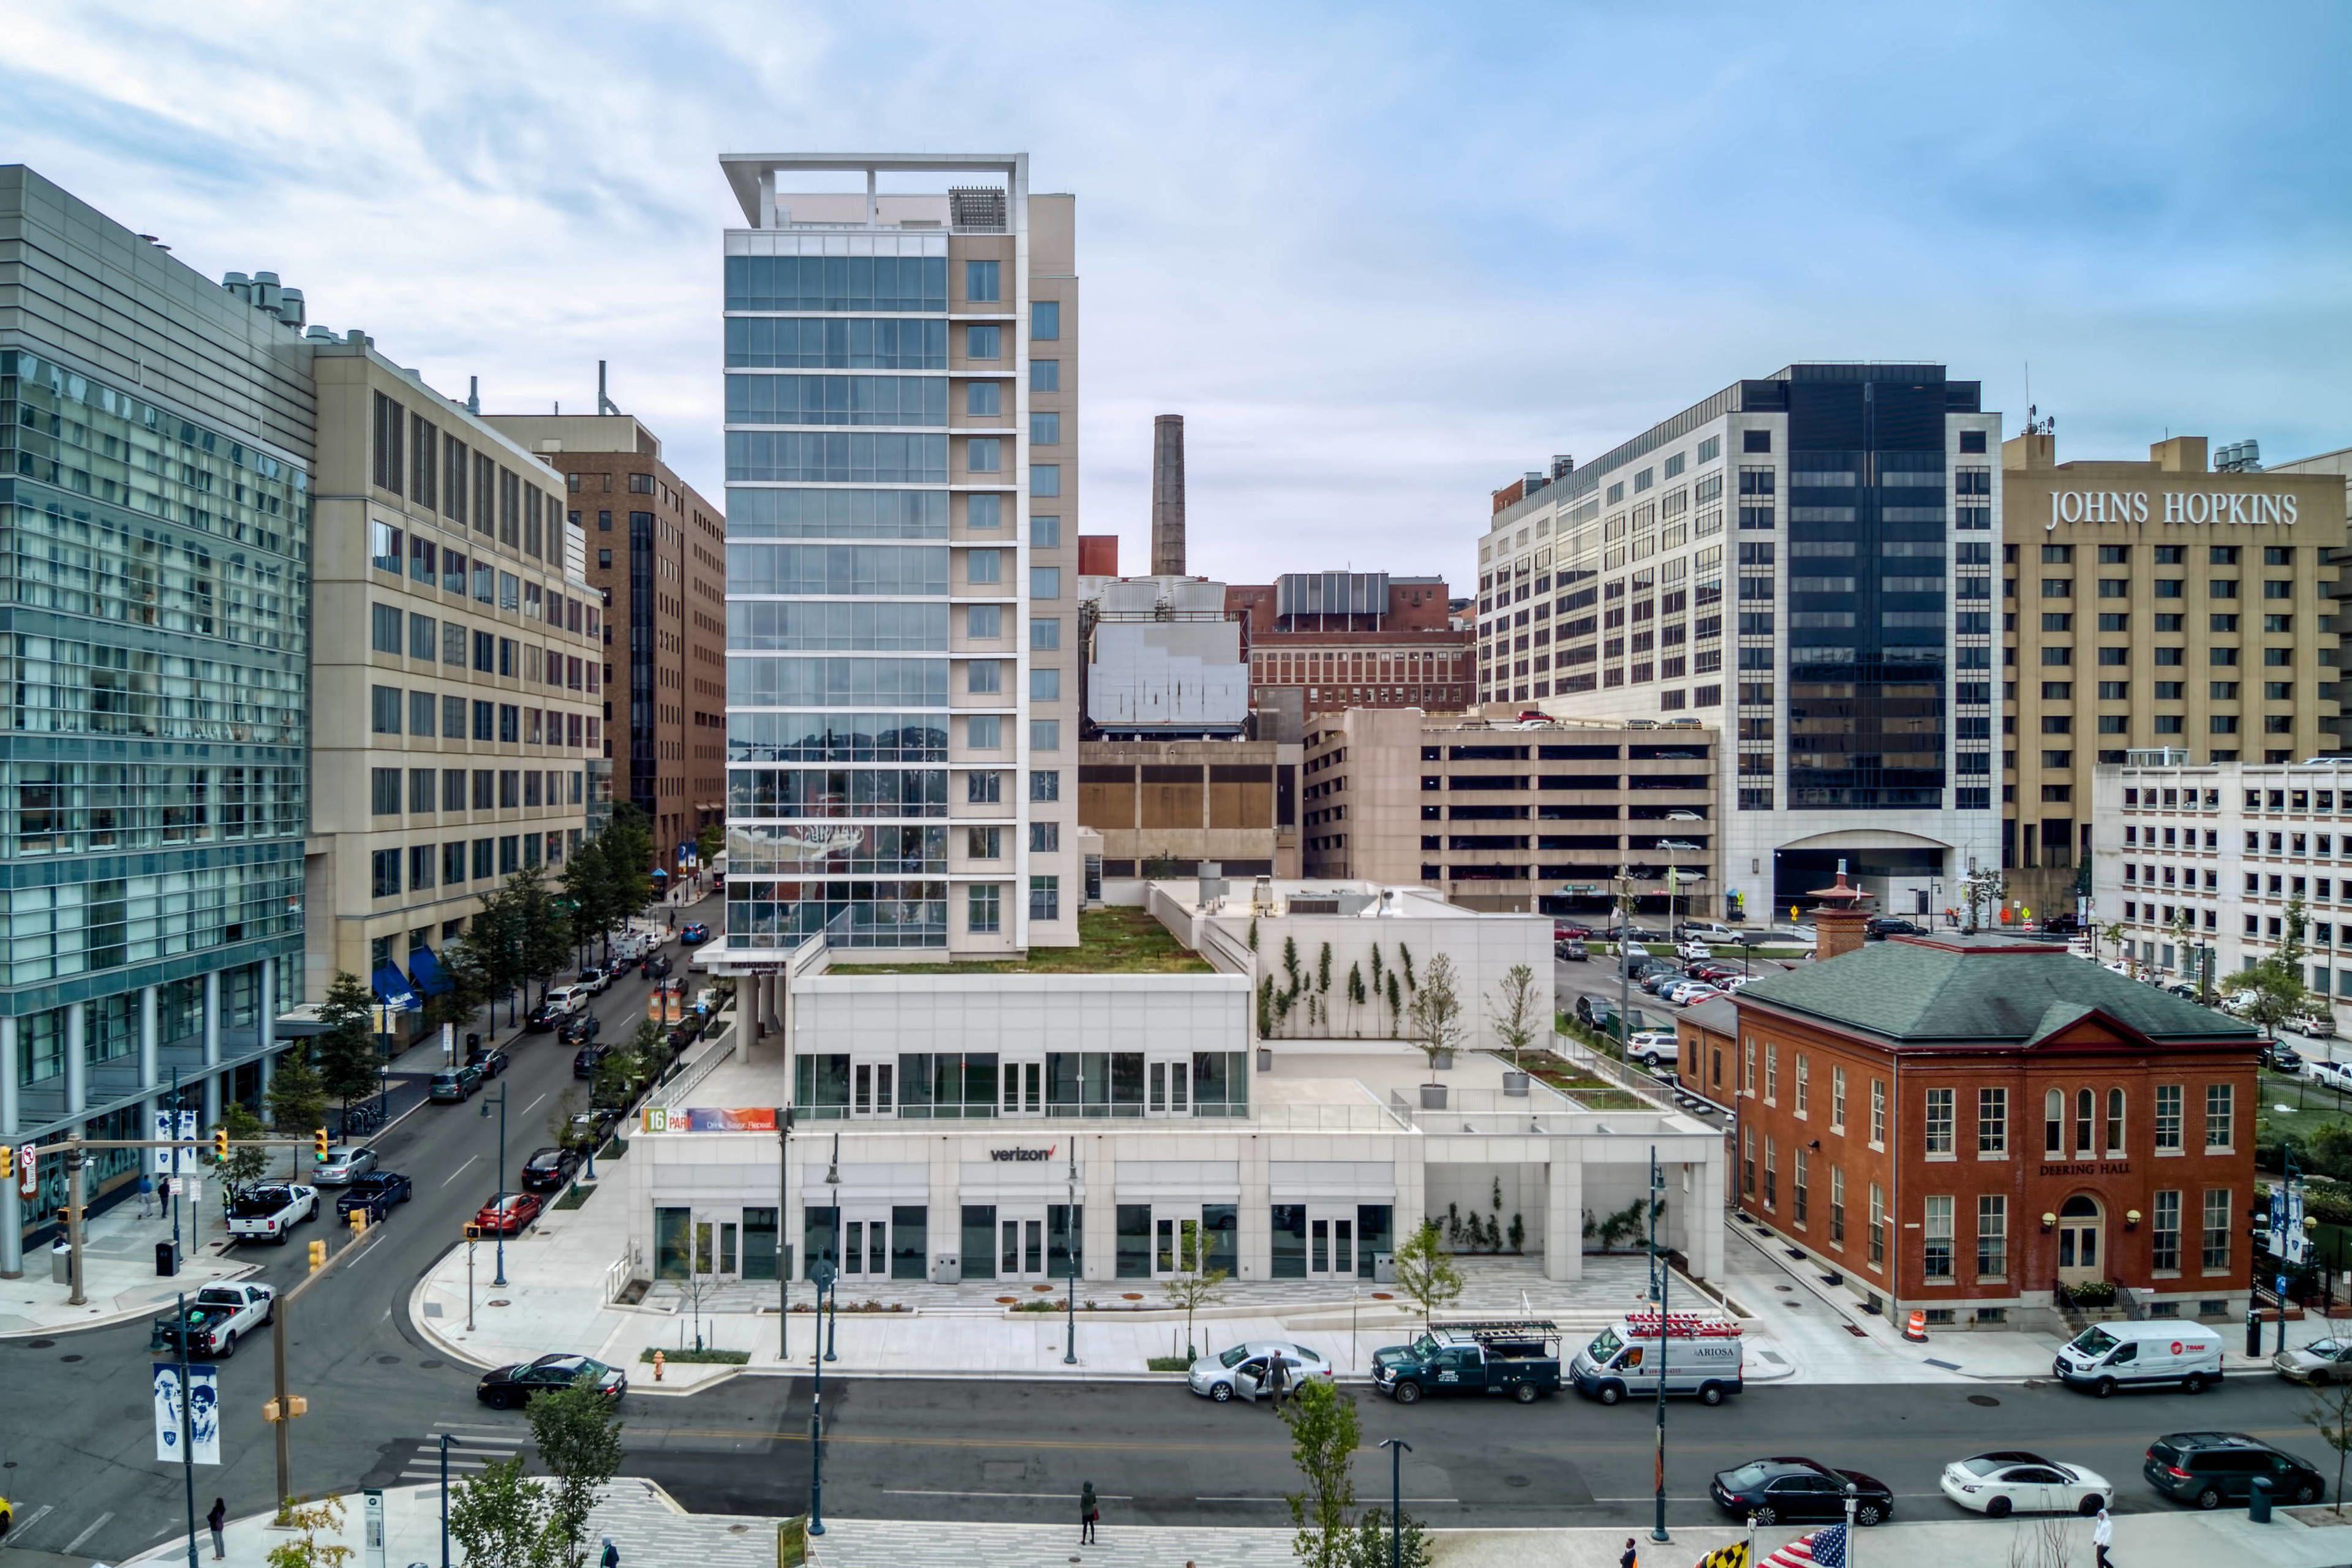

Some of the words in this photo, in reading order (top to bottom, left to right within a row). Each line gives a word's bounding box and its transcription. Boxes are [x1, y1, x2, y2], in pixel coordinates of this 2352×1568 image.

[2045, 491, 2149, 530] JOHNS
[2162, 492, 2298, 525] HOPKINS
[649, 1111, 664, 1129] 16
[990, 1147, 1049, 1161] verizon
[2040, 1164, 2094, 1176] DEERING
[2100, 1163, 2131, 1174] HALL
[1697, 1348, 1734, 1357] ARIOSA
